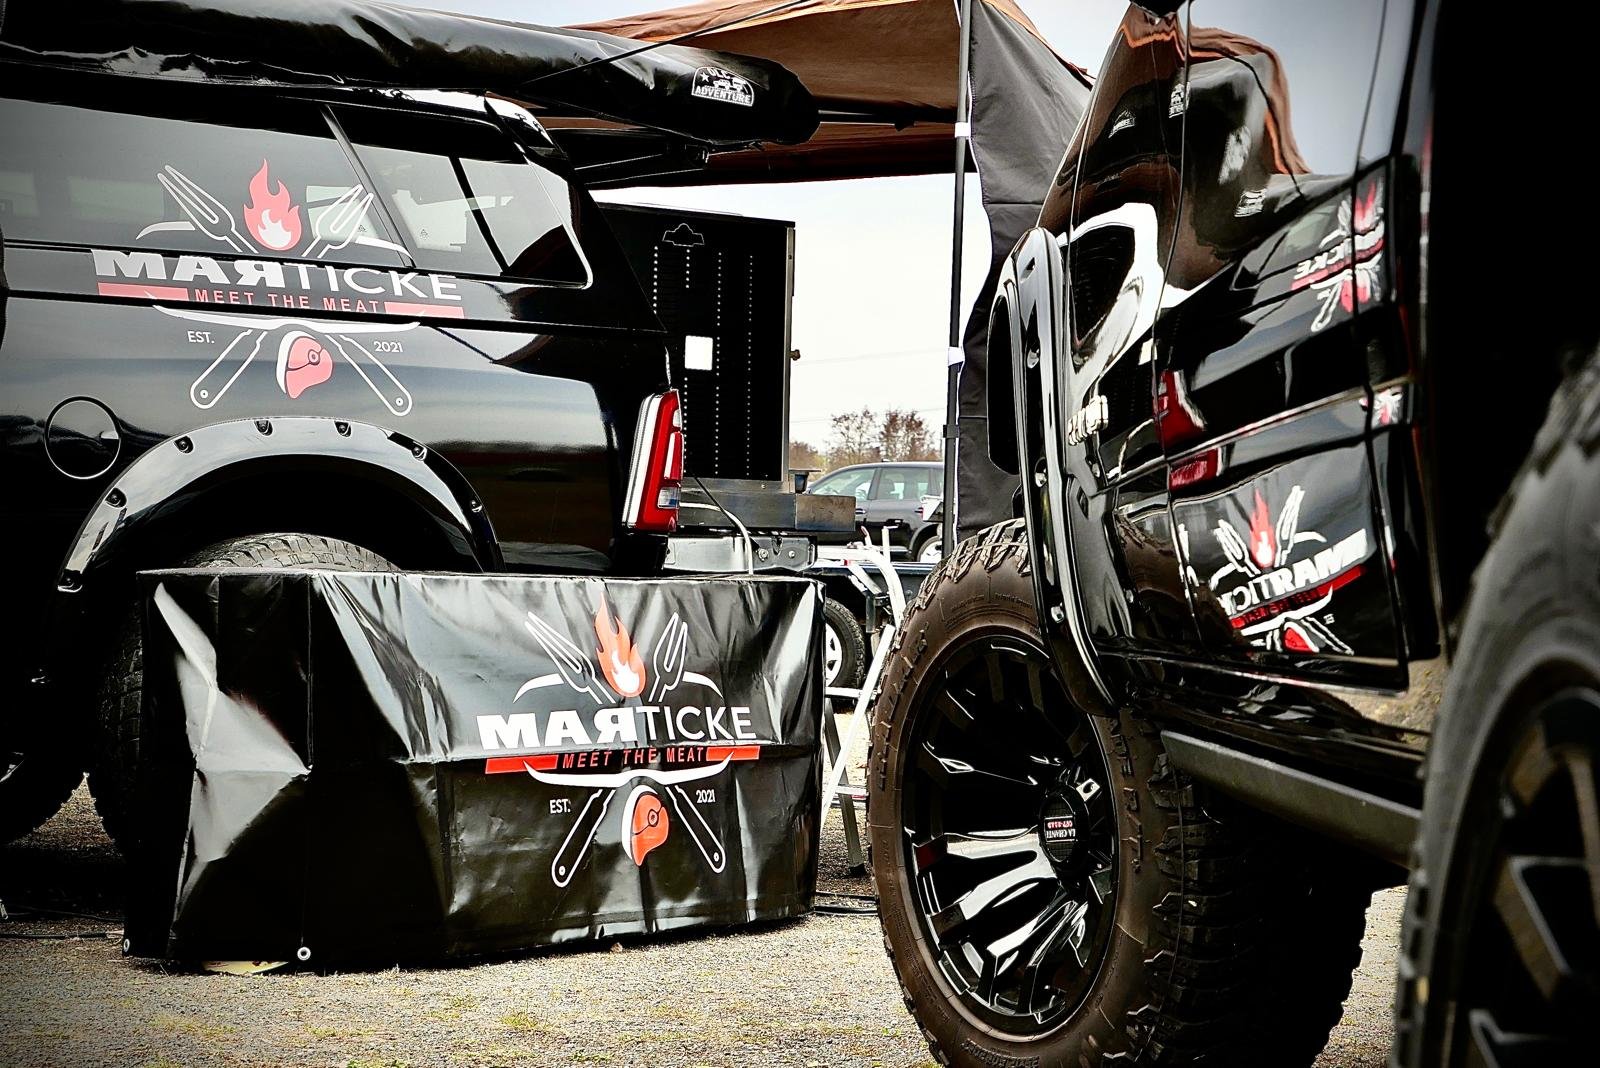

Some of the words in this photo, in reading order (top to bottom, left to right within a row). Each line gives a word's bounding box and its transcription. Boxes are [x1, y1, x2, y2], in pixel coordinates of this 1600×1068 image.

[695, 85, 751, 104] ADVENTURE
[194, 288, 254, 306] MEET
[268, 293, 309, 309] THE
[323, 297, 379, 313] MEAT
[187, 330, 215, 344] EST.
[373, 340, 404, 353] 2021
[562, 751, 612, 769] MEET
[623, 748, 657, 765] THE
[666, 747, 704, 763] MEAT
[696, 789, 716, 804] 2021
[550, 798, 571, 814] EST.
